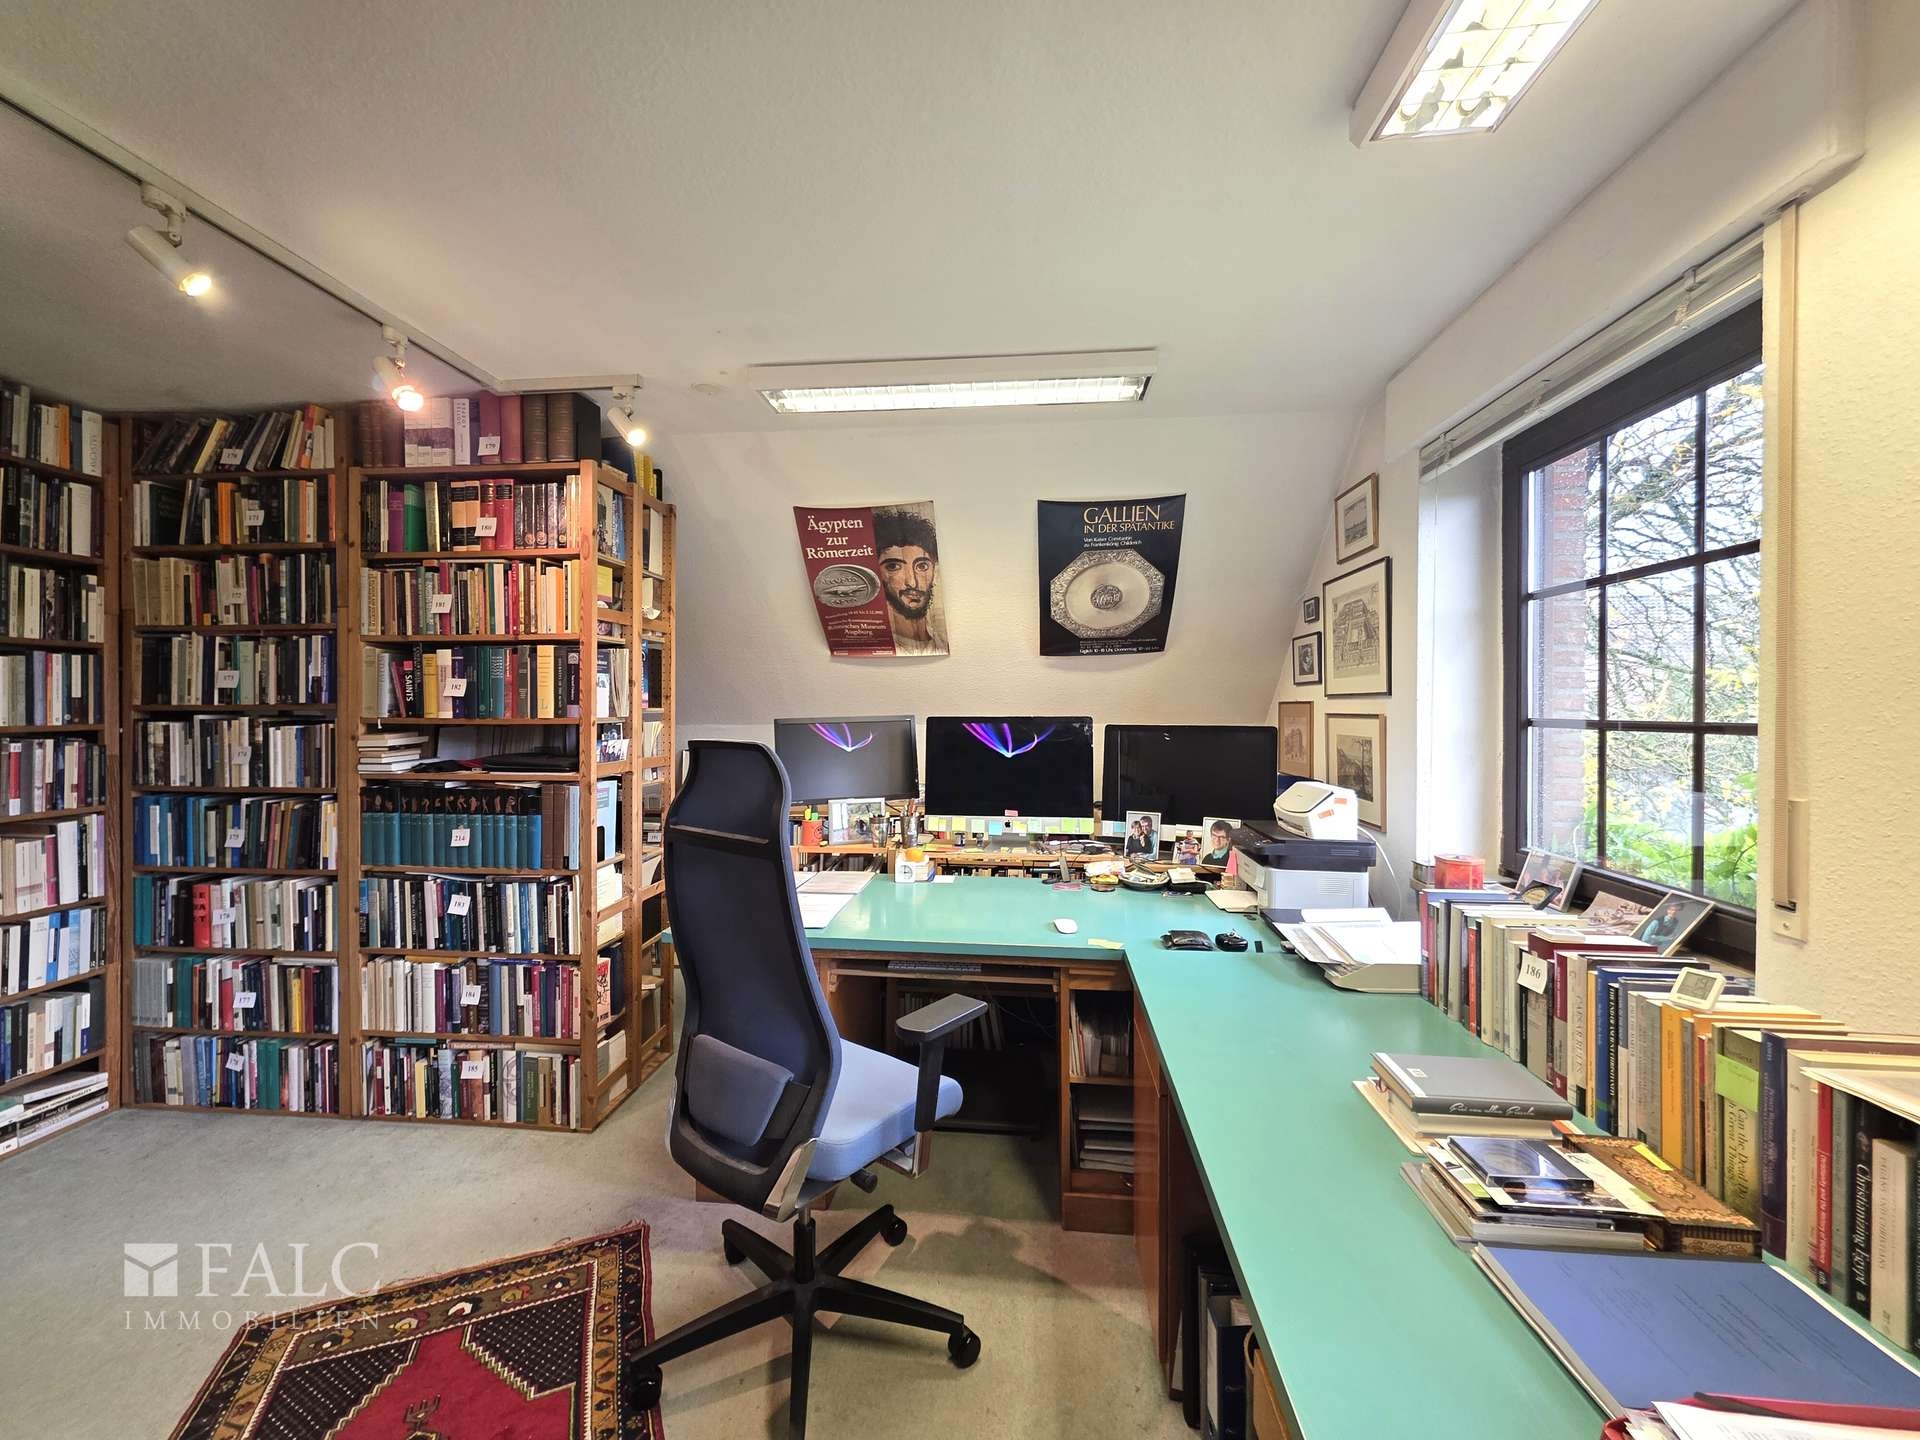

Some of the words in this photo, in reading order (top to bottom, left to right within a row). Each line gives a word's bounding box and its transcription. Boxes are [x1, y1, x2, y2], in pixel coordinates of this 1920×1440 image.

[807, 515, 864, 533] Ägypten
[1083, 505, 1161, 524] GALLIEN
[1084, 524, 1095, 534] IN
[1098, 523, 1118, 533] DER
[826, 535, 849, 546] zur
[806, 545, 874, 559] Römerzeit
[406, 674, 414, 702] SAINTS
[1525, 963, 1542, 979] 186
[1728, 1111, 1737, 1141] Great
[1737, 1107, 1748, 1130] Can
[1737, 1131, 1748, 1151] the
[1737, 1152, 1748, 1183] Dead
[1853, 1163, 1870, 1246] Christianizing
[1852, 1246, 1870, 1286] Egypt
